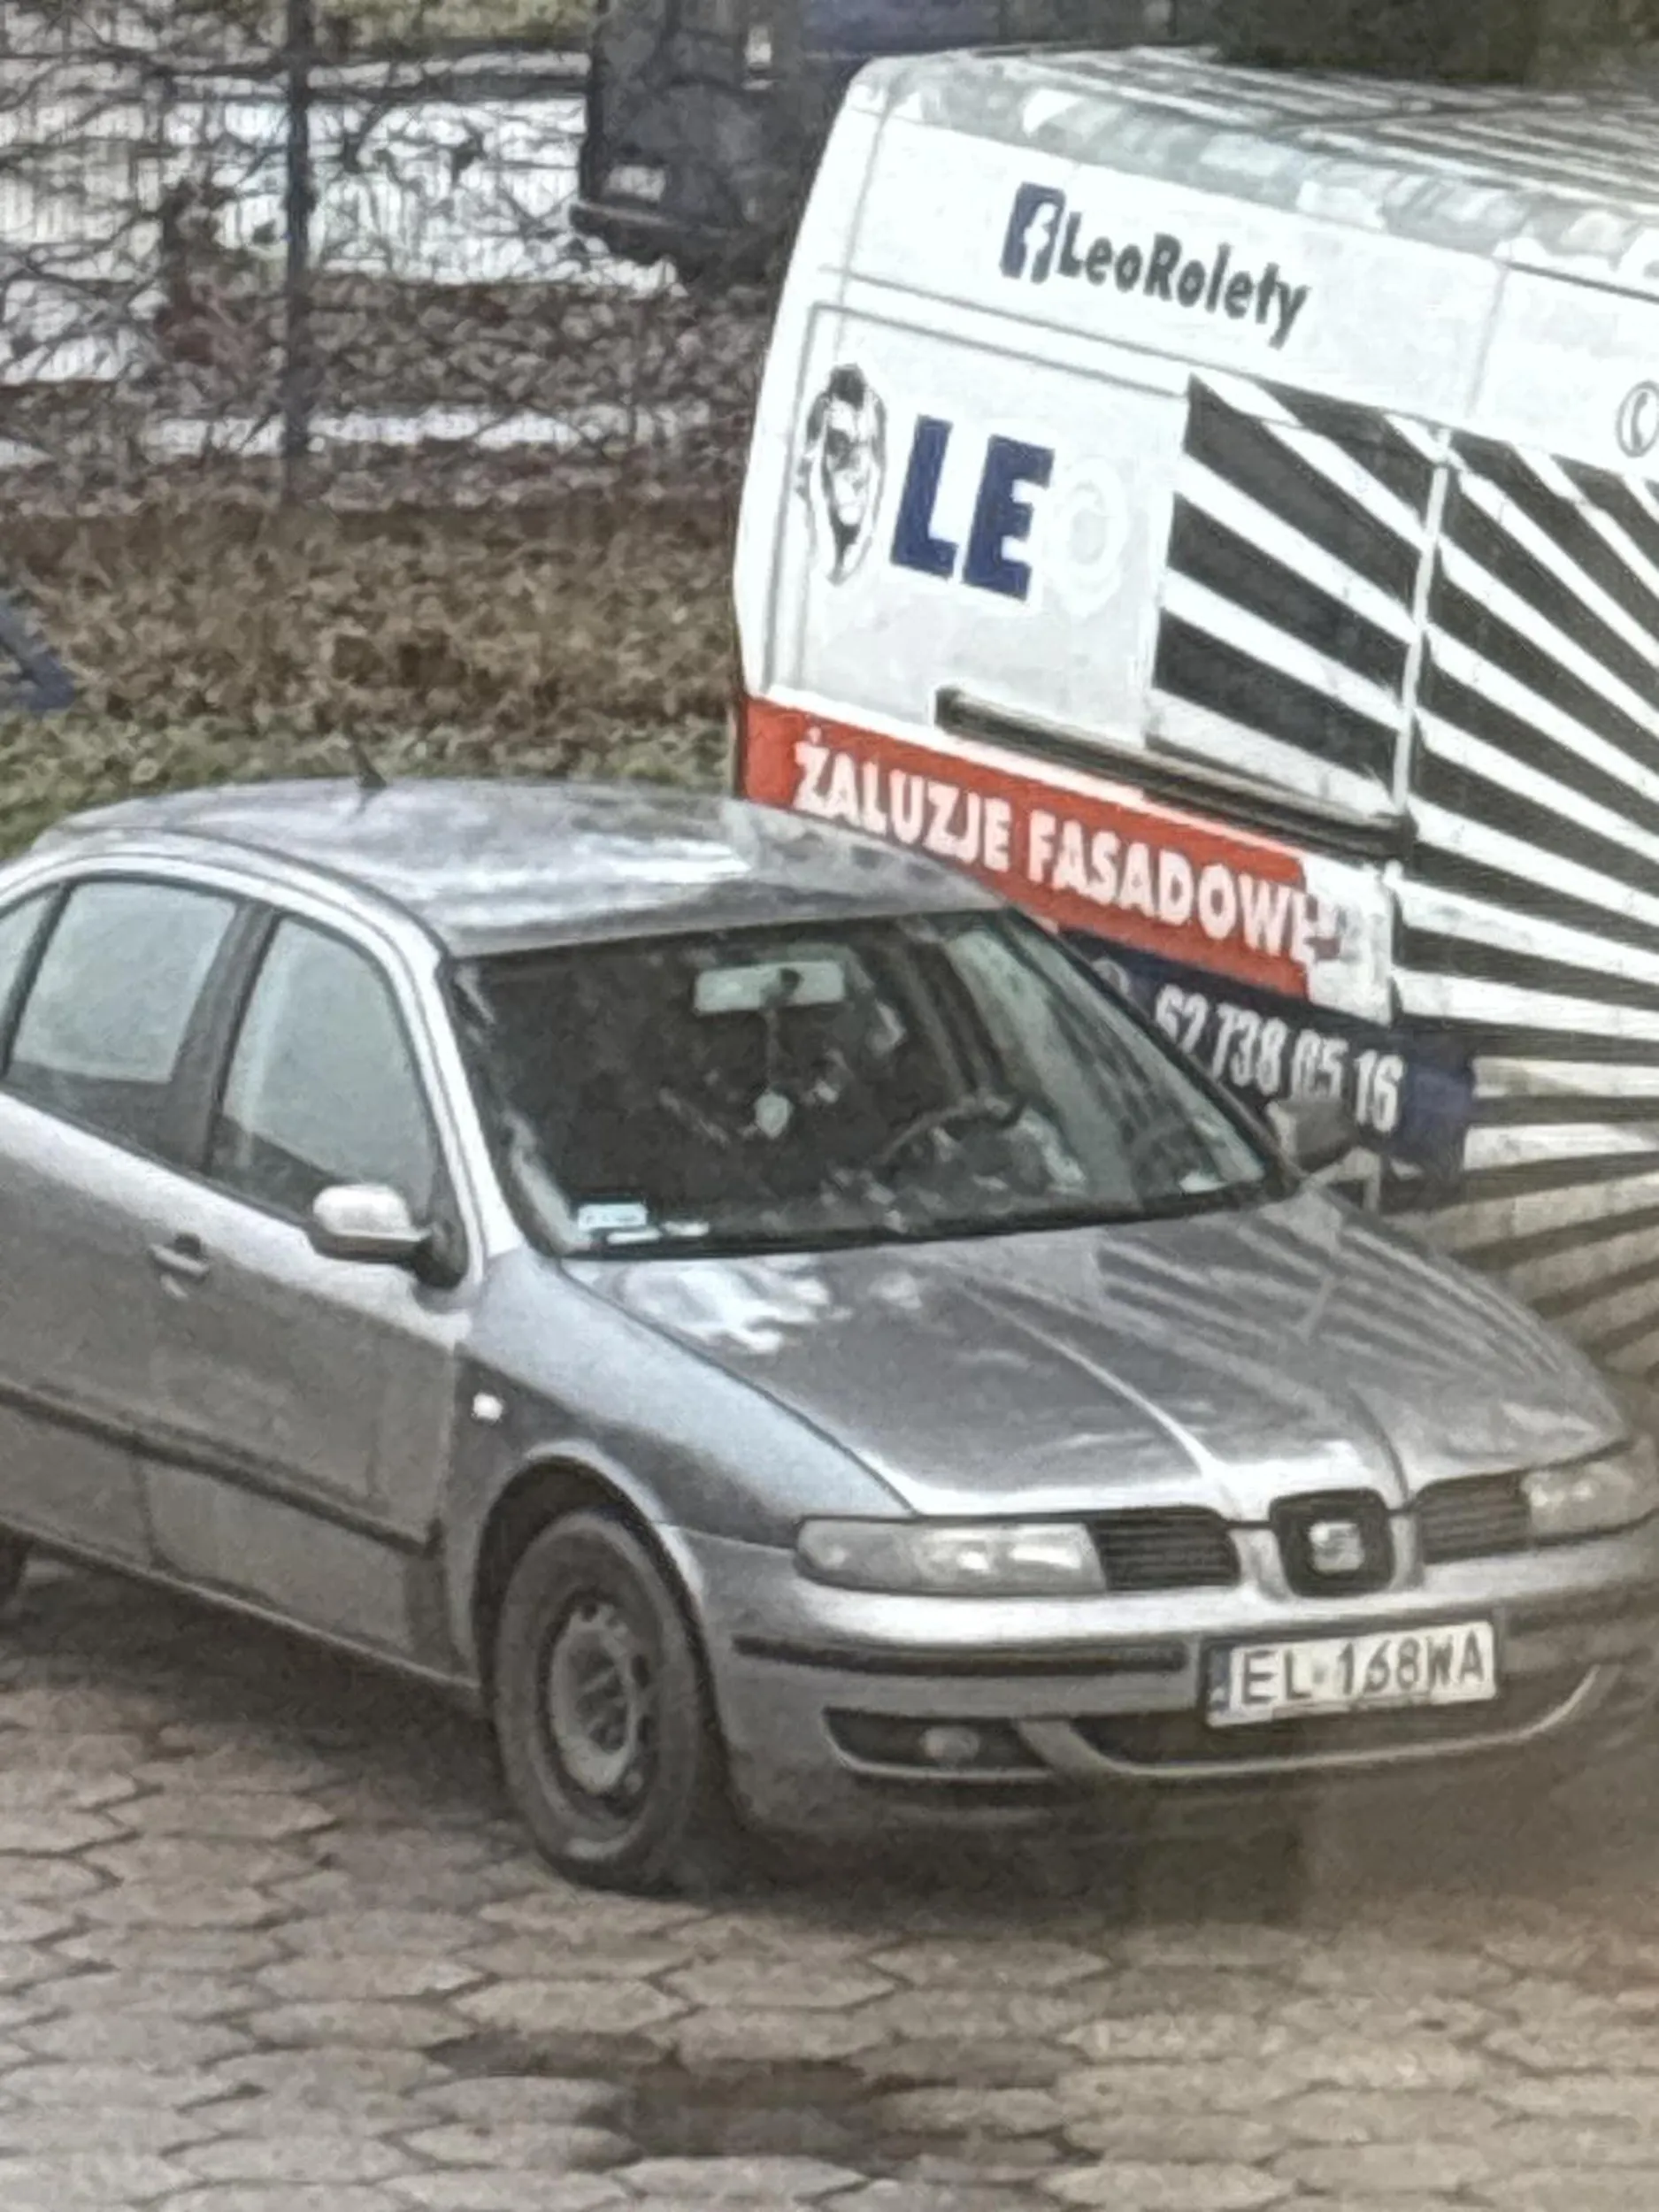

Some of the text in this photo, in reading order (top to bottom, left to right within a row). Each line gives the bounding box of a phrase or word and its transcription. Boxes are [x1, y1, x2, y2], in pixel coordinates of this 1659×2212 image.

[1056, 211, 1310, 350] LeoRolety
[793, 726, 1011, 872] ŻALUZJE
[1212, 1002, 1288, 1095] 738
[1355, 1049, 1404, 1133] 16
